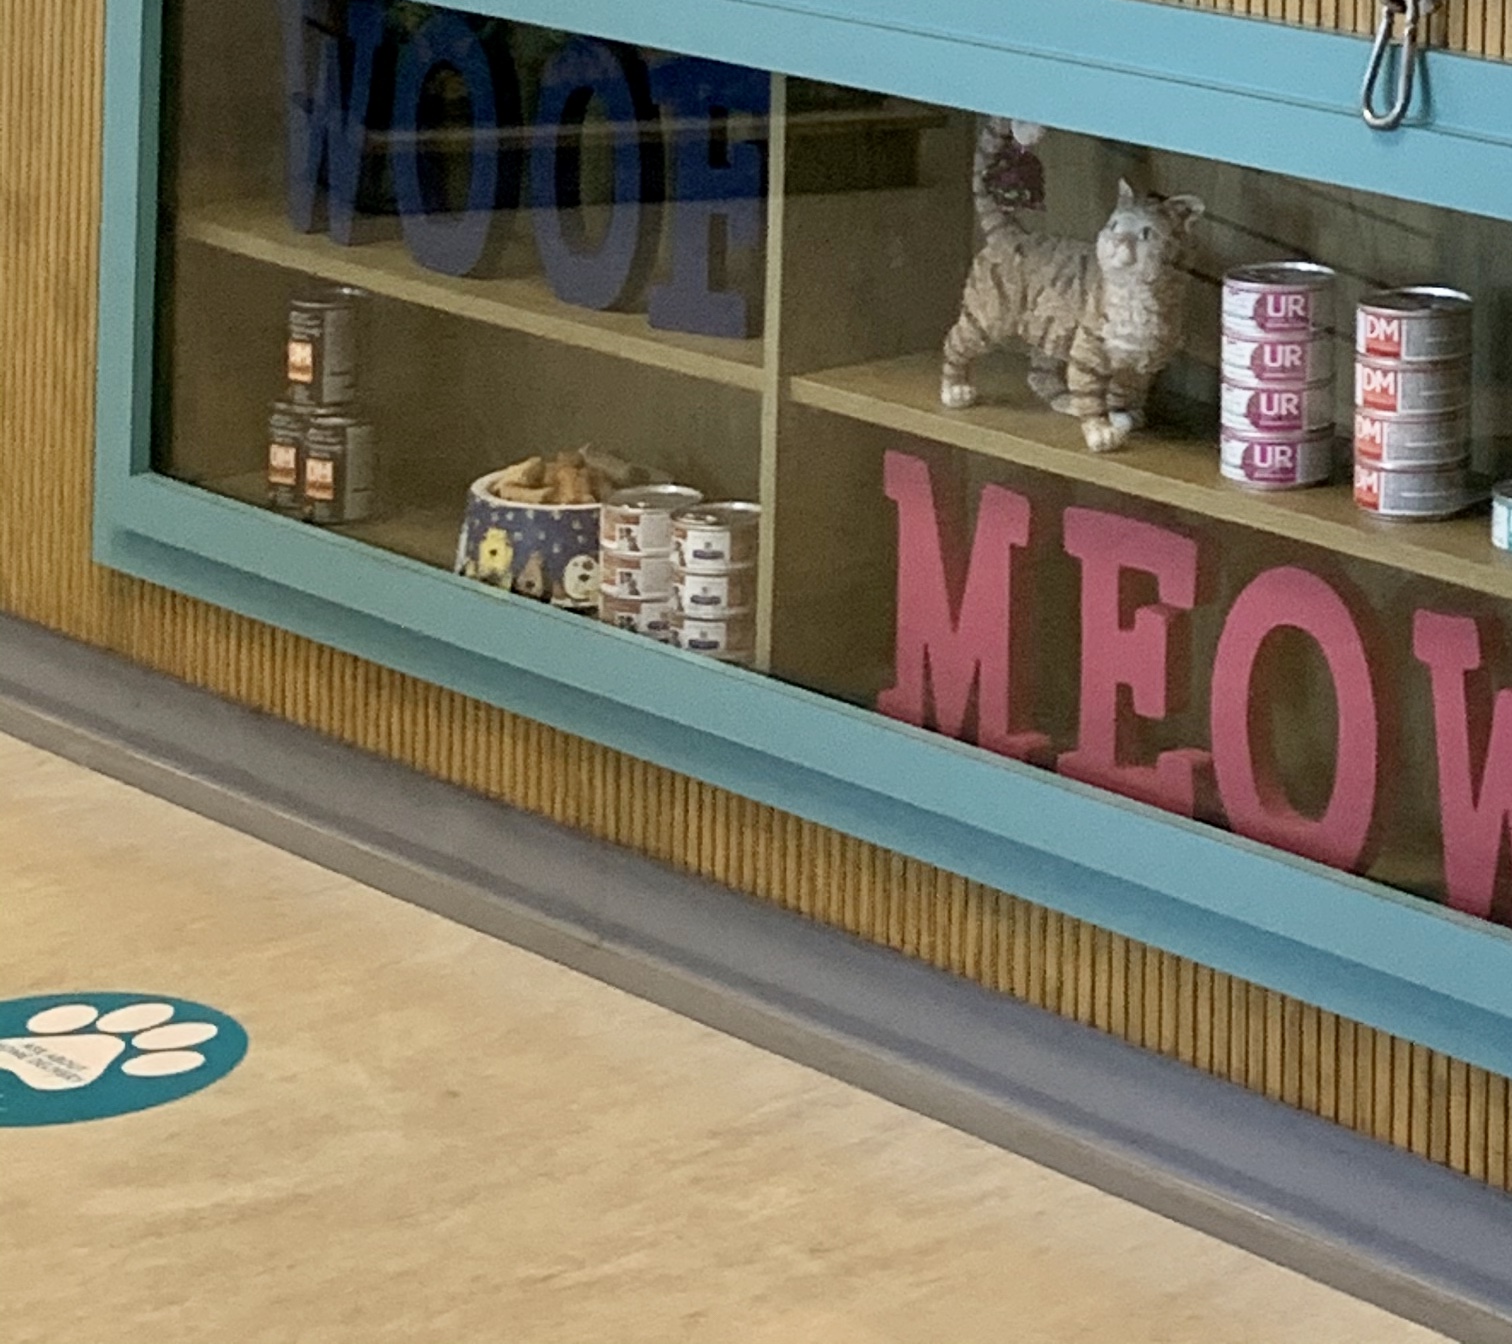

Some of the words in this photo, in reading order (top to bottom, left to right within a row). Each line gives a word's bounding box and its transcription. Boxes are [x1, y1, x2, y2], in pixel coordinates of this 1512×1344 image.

[1266, 294, 1306, 318] UR
[1365, 317, 1399, 341] DM
[1263, 344, 1302, 368] UR
[1362, 371, 1396, 395] DM
[1259, 393, 1299, 415] UR
[1355, 416, 1382, 443] DM
[1252, 445, 1293, 468] UR
